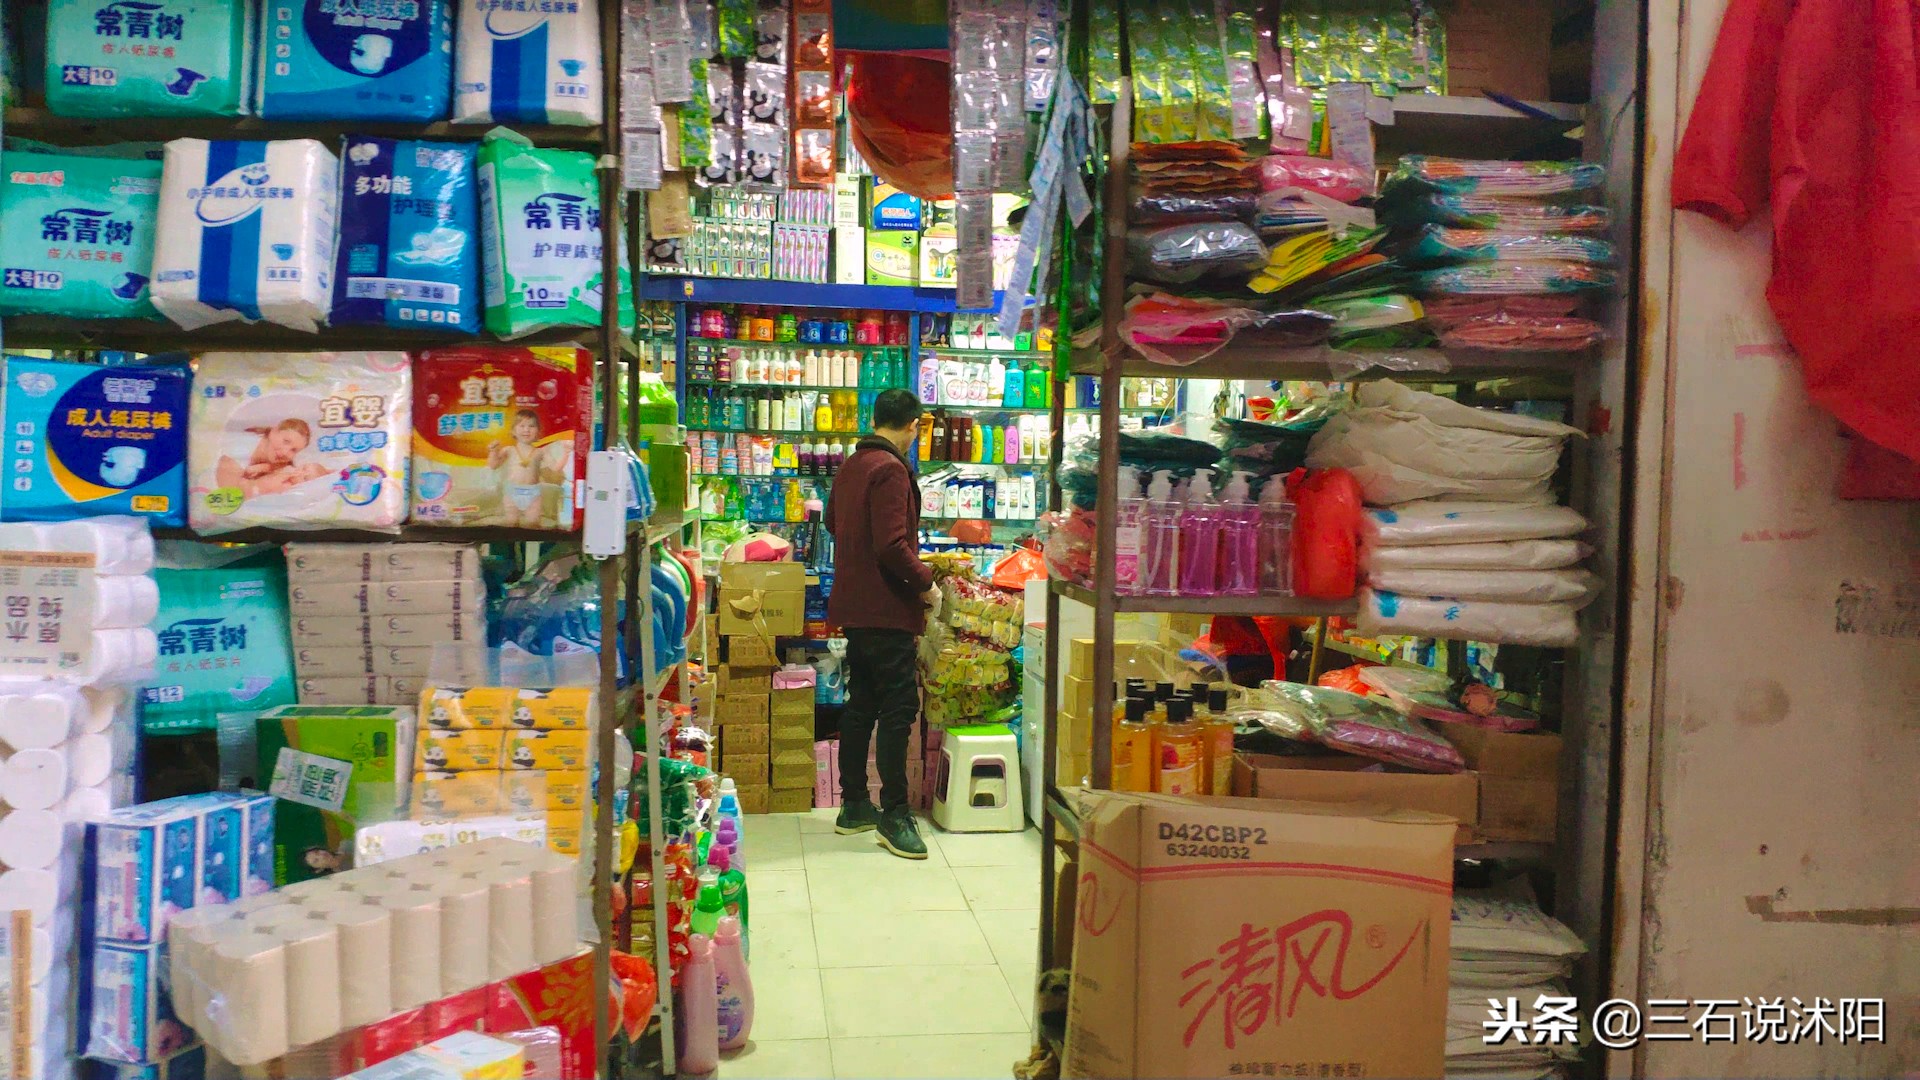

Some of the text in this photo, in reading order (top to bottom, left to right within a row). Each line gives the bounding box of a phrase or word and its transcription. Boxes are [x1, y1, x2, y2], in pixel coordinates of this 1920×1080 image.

[94, 8, 184, 41] 常青树
[354, 174, 413, 195] 多功能
[41, 213, 134, 246] 常青树
[458, 375, 515, 408] 宜婴
[66, 408, 172, 430] 成人纸尿裤
[318, 395, 386, 428] 宜婴
[157, 623, 248, 656] 常青树
[1158, 821, 1269, 846] D42CBP2
[1166, 842, 1251, 860] 63240032
[1178, 908, 1425, 1051] 清风
